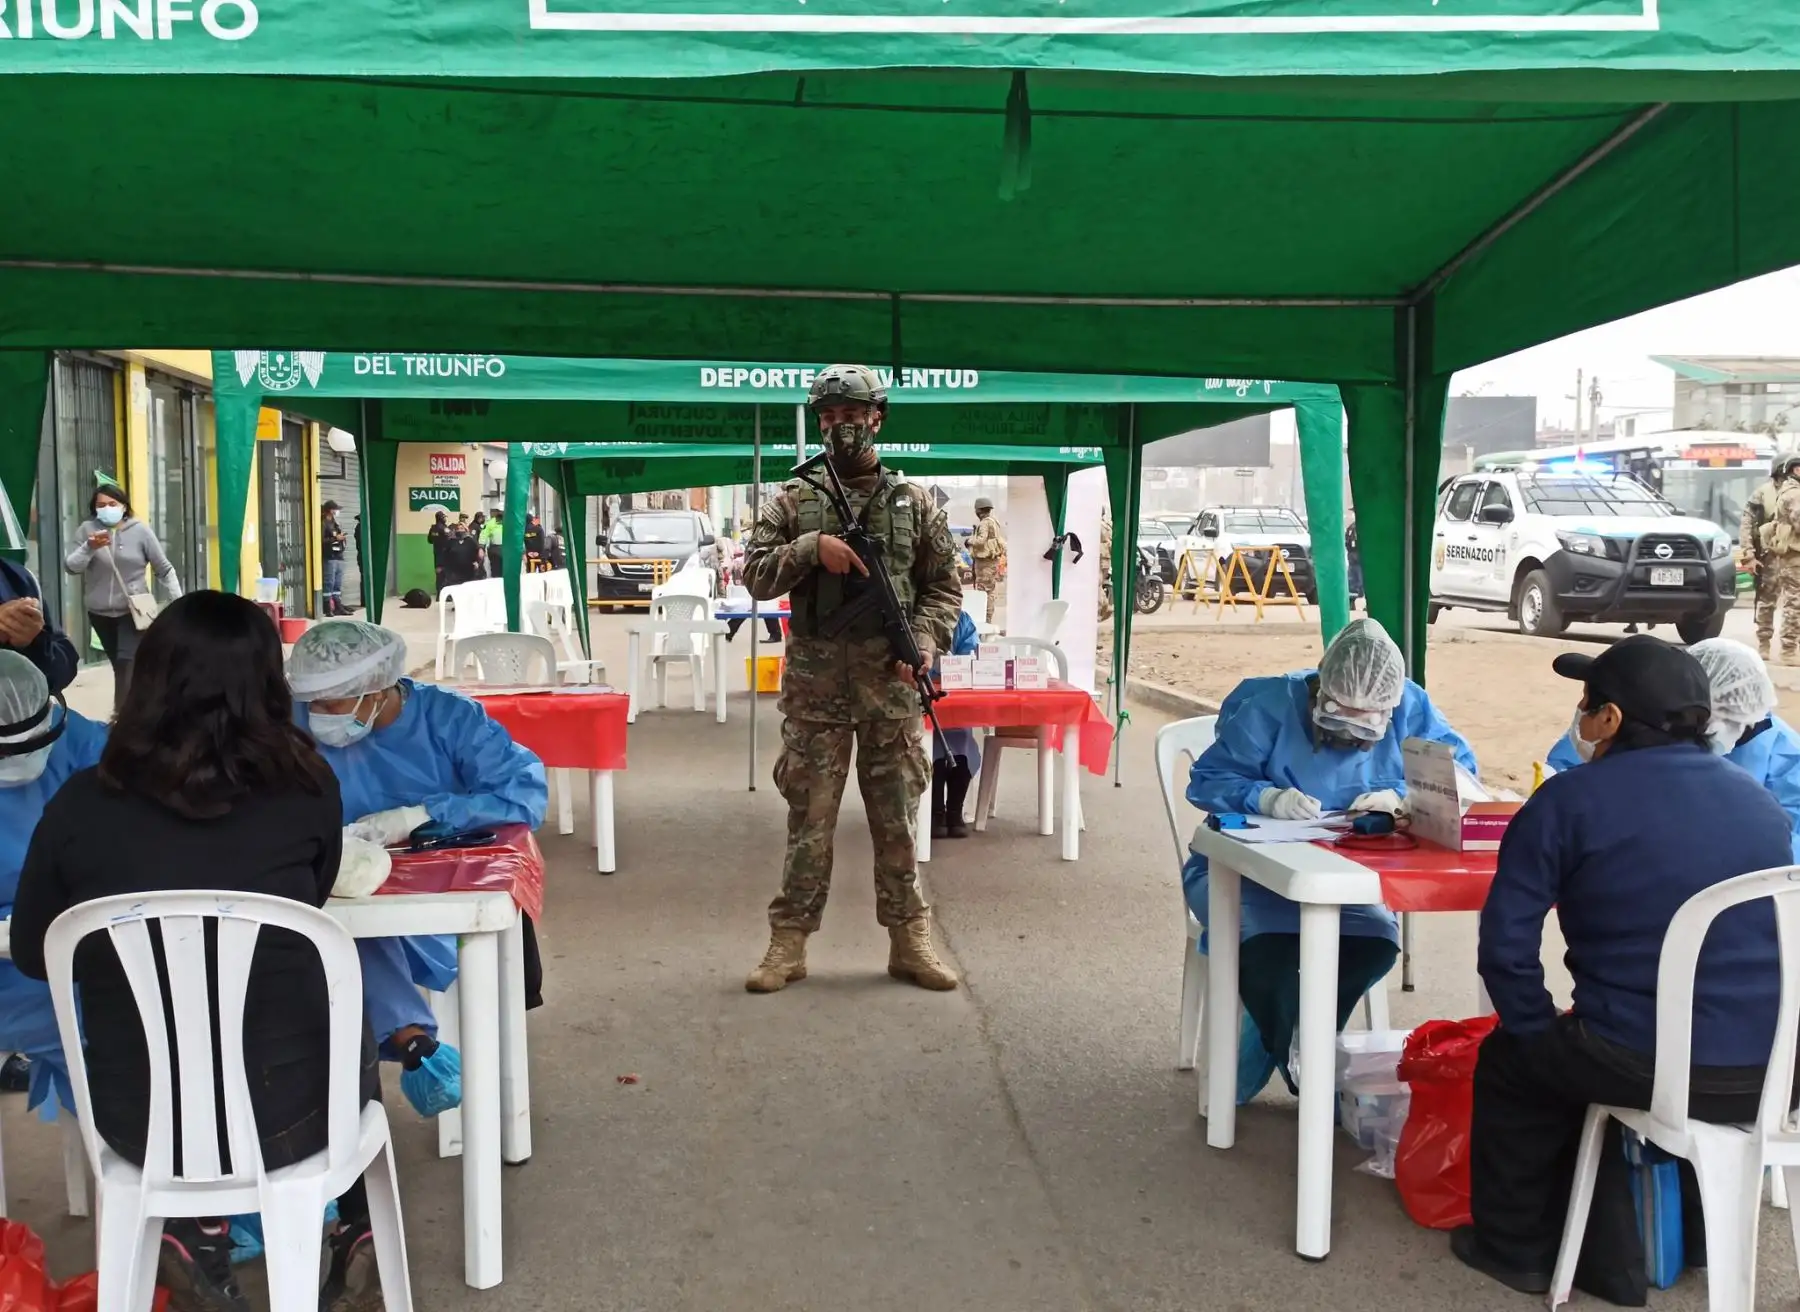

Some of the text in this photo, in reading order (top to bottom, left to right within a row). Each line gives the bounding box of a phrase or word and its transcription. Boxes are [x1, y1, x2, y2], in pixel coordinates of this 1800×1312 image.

[0, 0, 258, 40] IUNFO
[354, 355, 506, 377] DEL TRIUNFO
[700, 367, 979, 389] DEPORTE VENTUD
[430, 457, 465, 471] SALIDA
[411, 490, 458, 500] SALIDA
[1446, 545, 1493, 562] SERENAZGO
